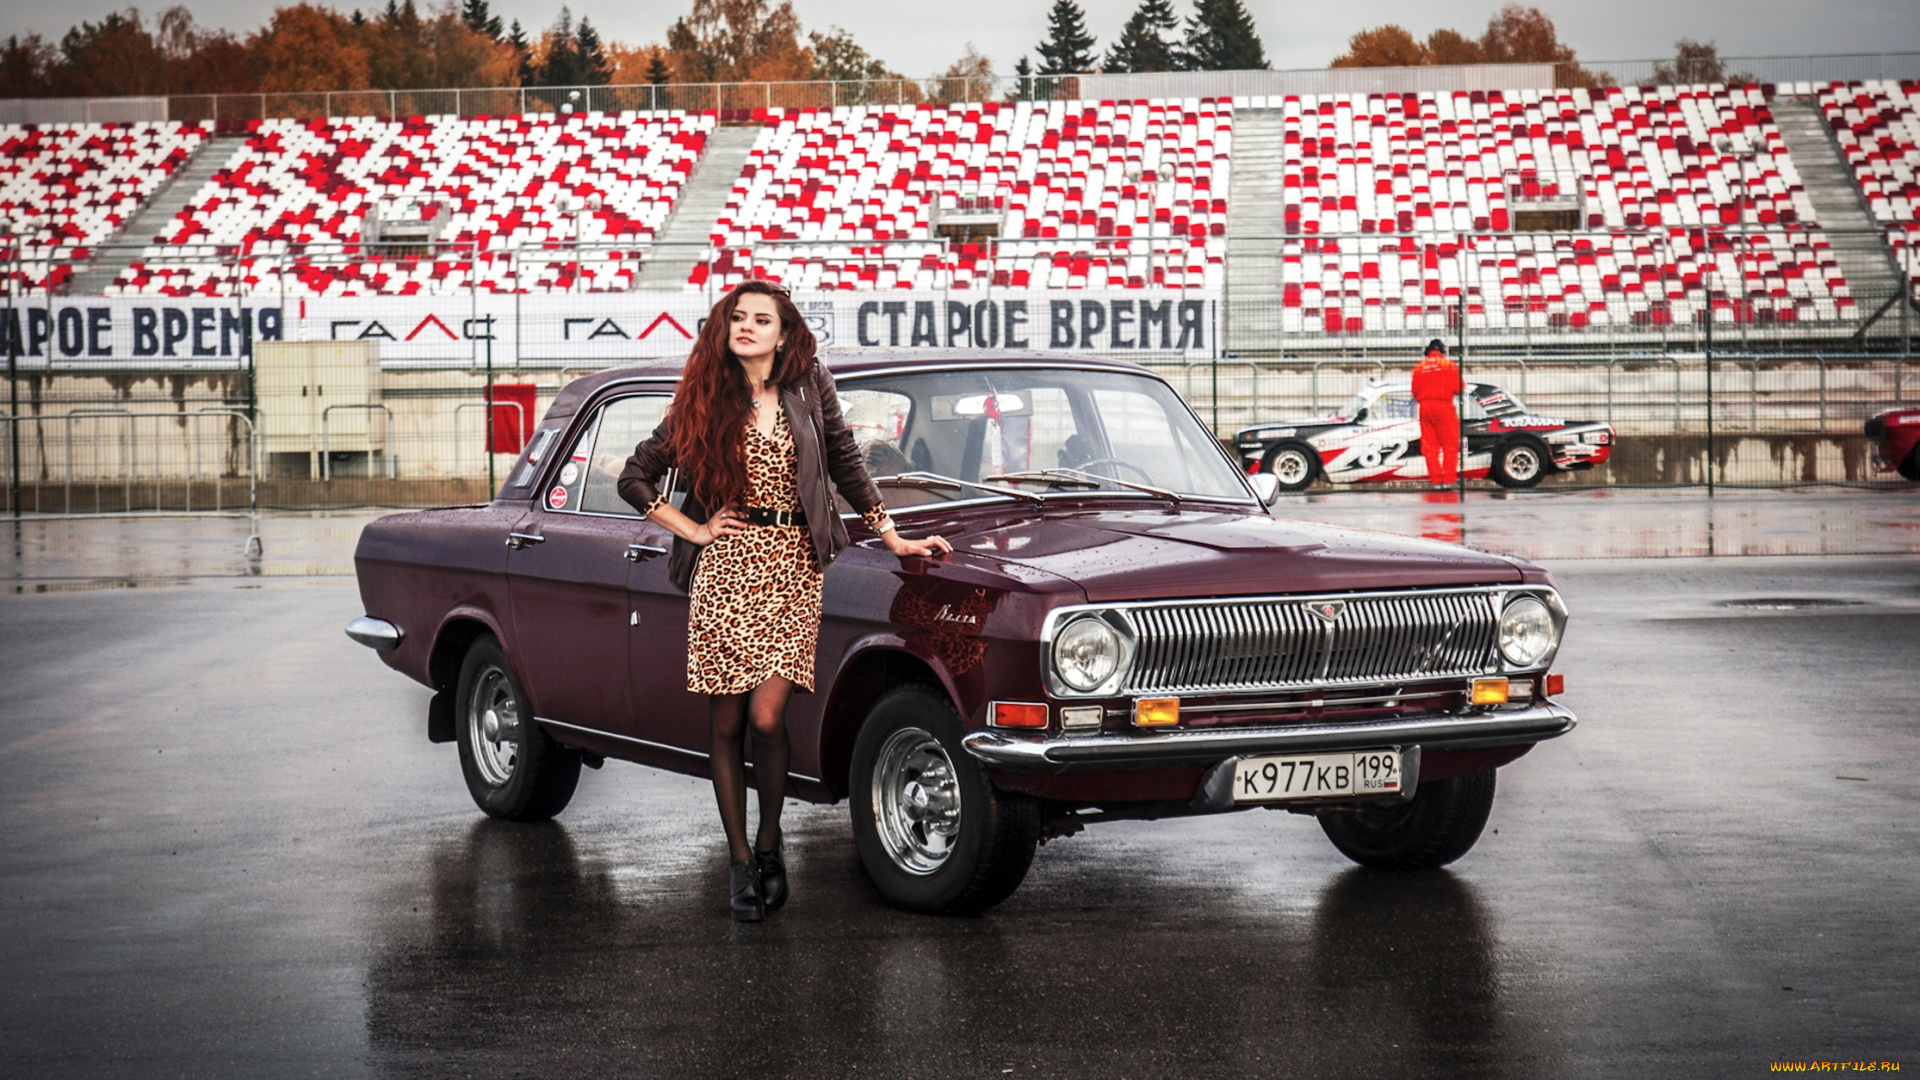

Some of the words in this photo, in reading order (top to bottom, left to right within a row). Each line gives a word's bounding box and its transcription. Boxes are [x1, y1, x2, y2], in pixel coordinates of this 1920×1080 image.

[0, 307, 112, 357] АРОЕ
[132, 307, 282, 357] ВРЕМЯ
[857, 300, 1029, 349] СТАРОЕ
[1050, 299, 1204, 349] ВРЕМЯ
[1358, 438, 1409, 468] 82
[1244, 760, 1350, 795] К977КВ
[1357, 755, 1394, 779] 199
[1364, 779, 1383, 789] RUS
